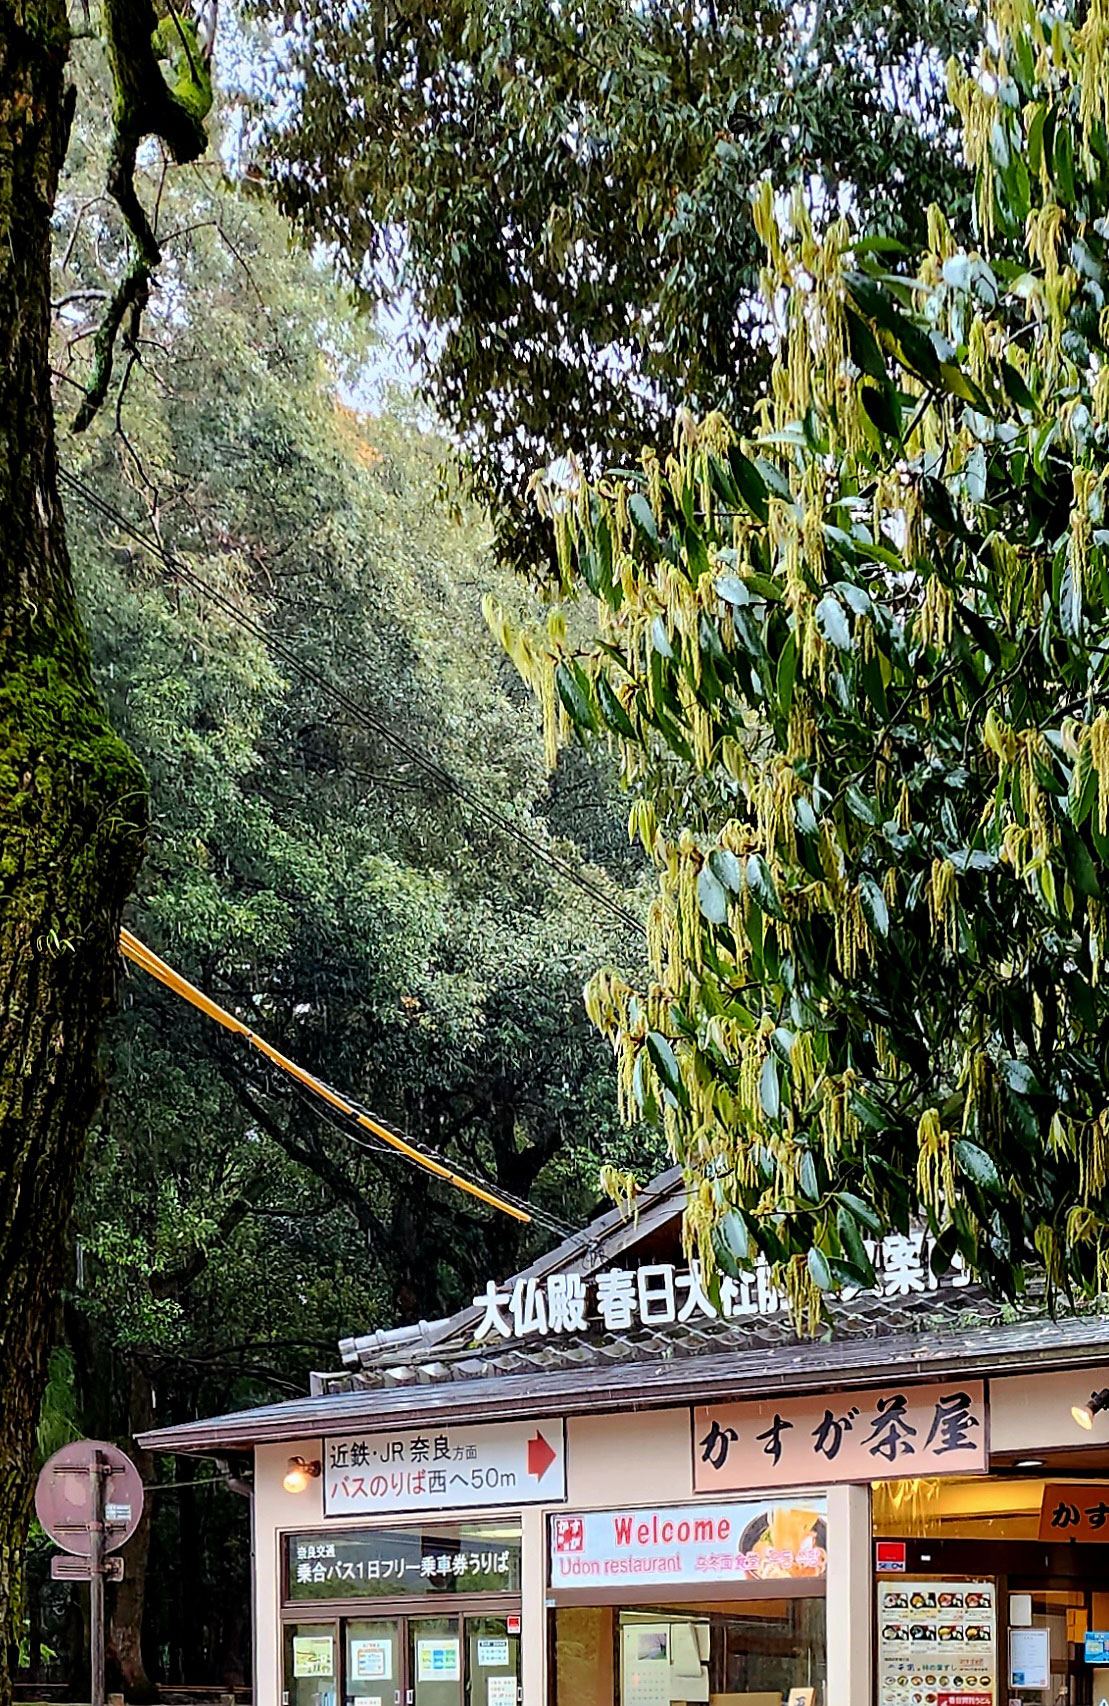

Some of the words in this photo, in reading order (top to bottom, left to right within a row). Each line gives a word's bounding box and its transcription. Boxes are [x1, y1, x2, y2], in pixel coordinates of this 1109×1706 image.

[473, 1274, 588, 1339] 大仏殿
[698, 1391, 980, 1470] かすが茶屋
[330, 1467, 517, 1499] バスのりば西へ50m
[614, 1515, 731, 1546] Welcome
[297, 1545, 336, 1559] 奈良交通
[559, 1556, 600, 1575] Udon
[604, 1553, 682, 1574] restaurant
